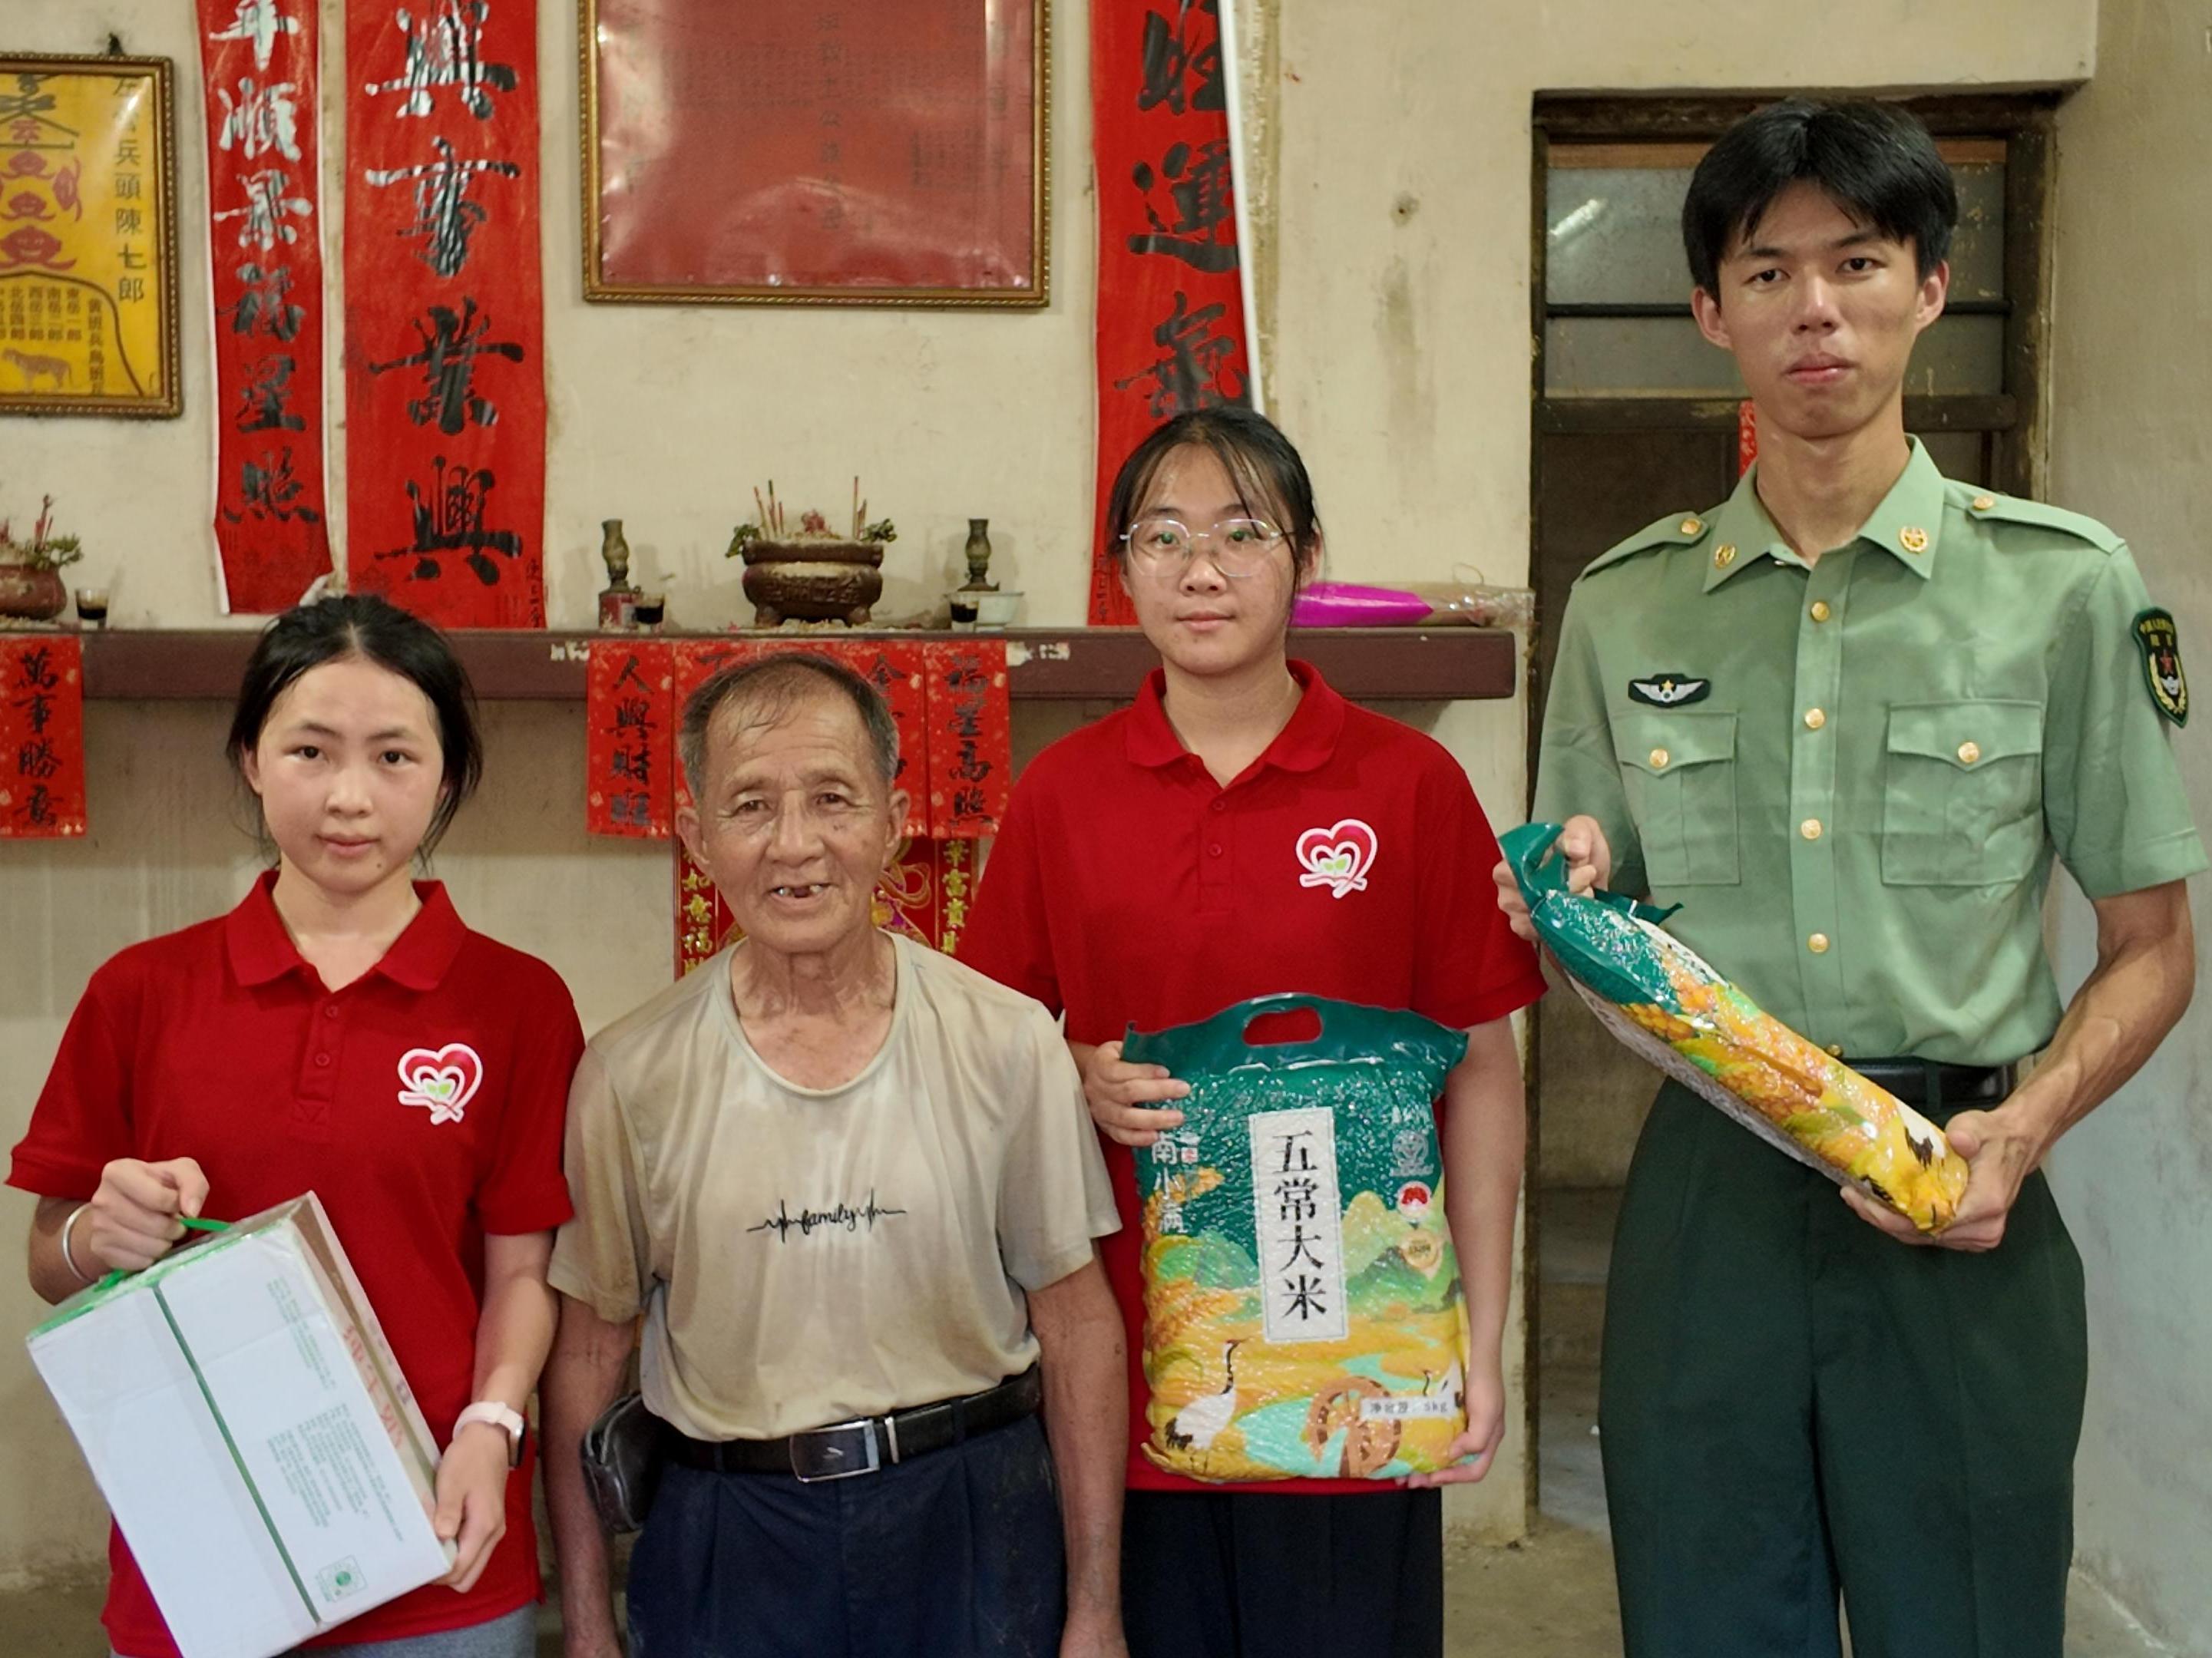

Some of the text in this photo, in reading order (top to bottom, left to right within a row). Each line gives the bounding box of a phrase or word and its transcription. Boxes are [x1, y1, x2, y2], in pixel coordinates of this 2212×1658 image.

[801, 1202, 857, 1237] family
[1272, 1130, 1327, 1320] 五常大米
